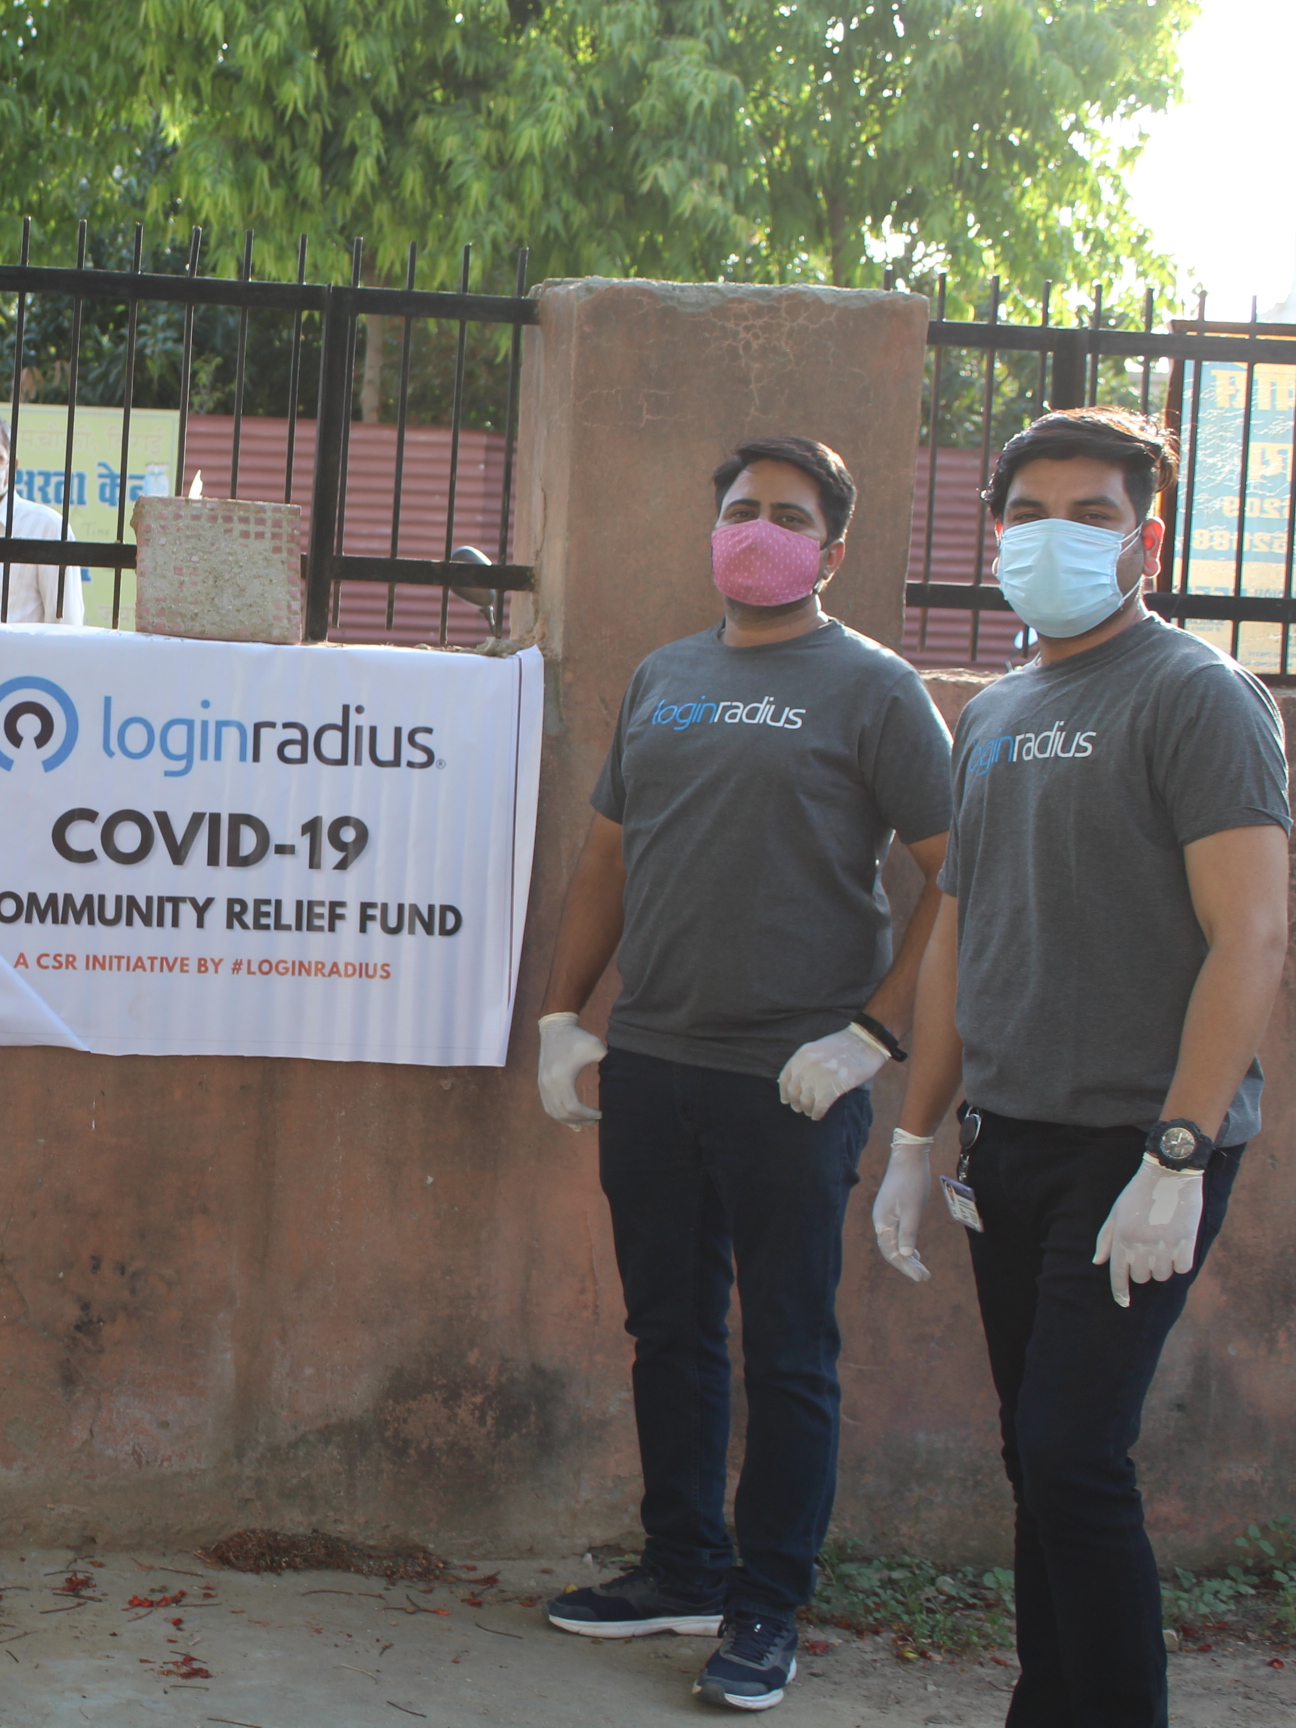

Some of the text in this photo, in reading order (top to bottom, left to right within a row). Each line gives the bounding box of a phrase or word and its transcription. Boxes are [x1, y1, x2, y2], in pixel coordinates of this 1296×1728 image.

[652, 695, 807, 731] loginradius
[968, 720, 1097, 777] oginradius
[51, 807, 370, 871] COVID-19
[225, 898, 347, 934] RELIEF
[358, 902, 463, 937] FUND
[13, 952, 392, 980] A CSR INITIATIVE BY #LOGINRADIUS
